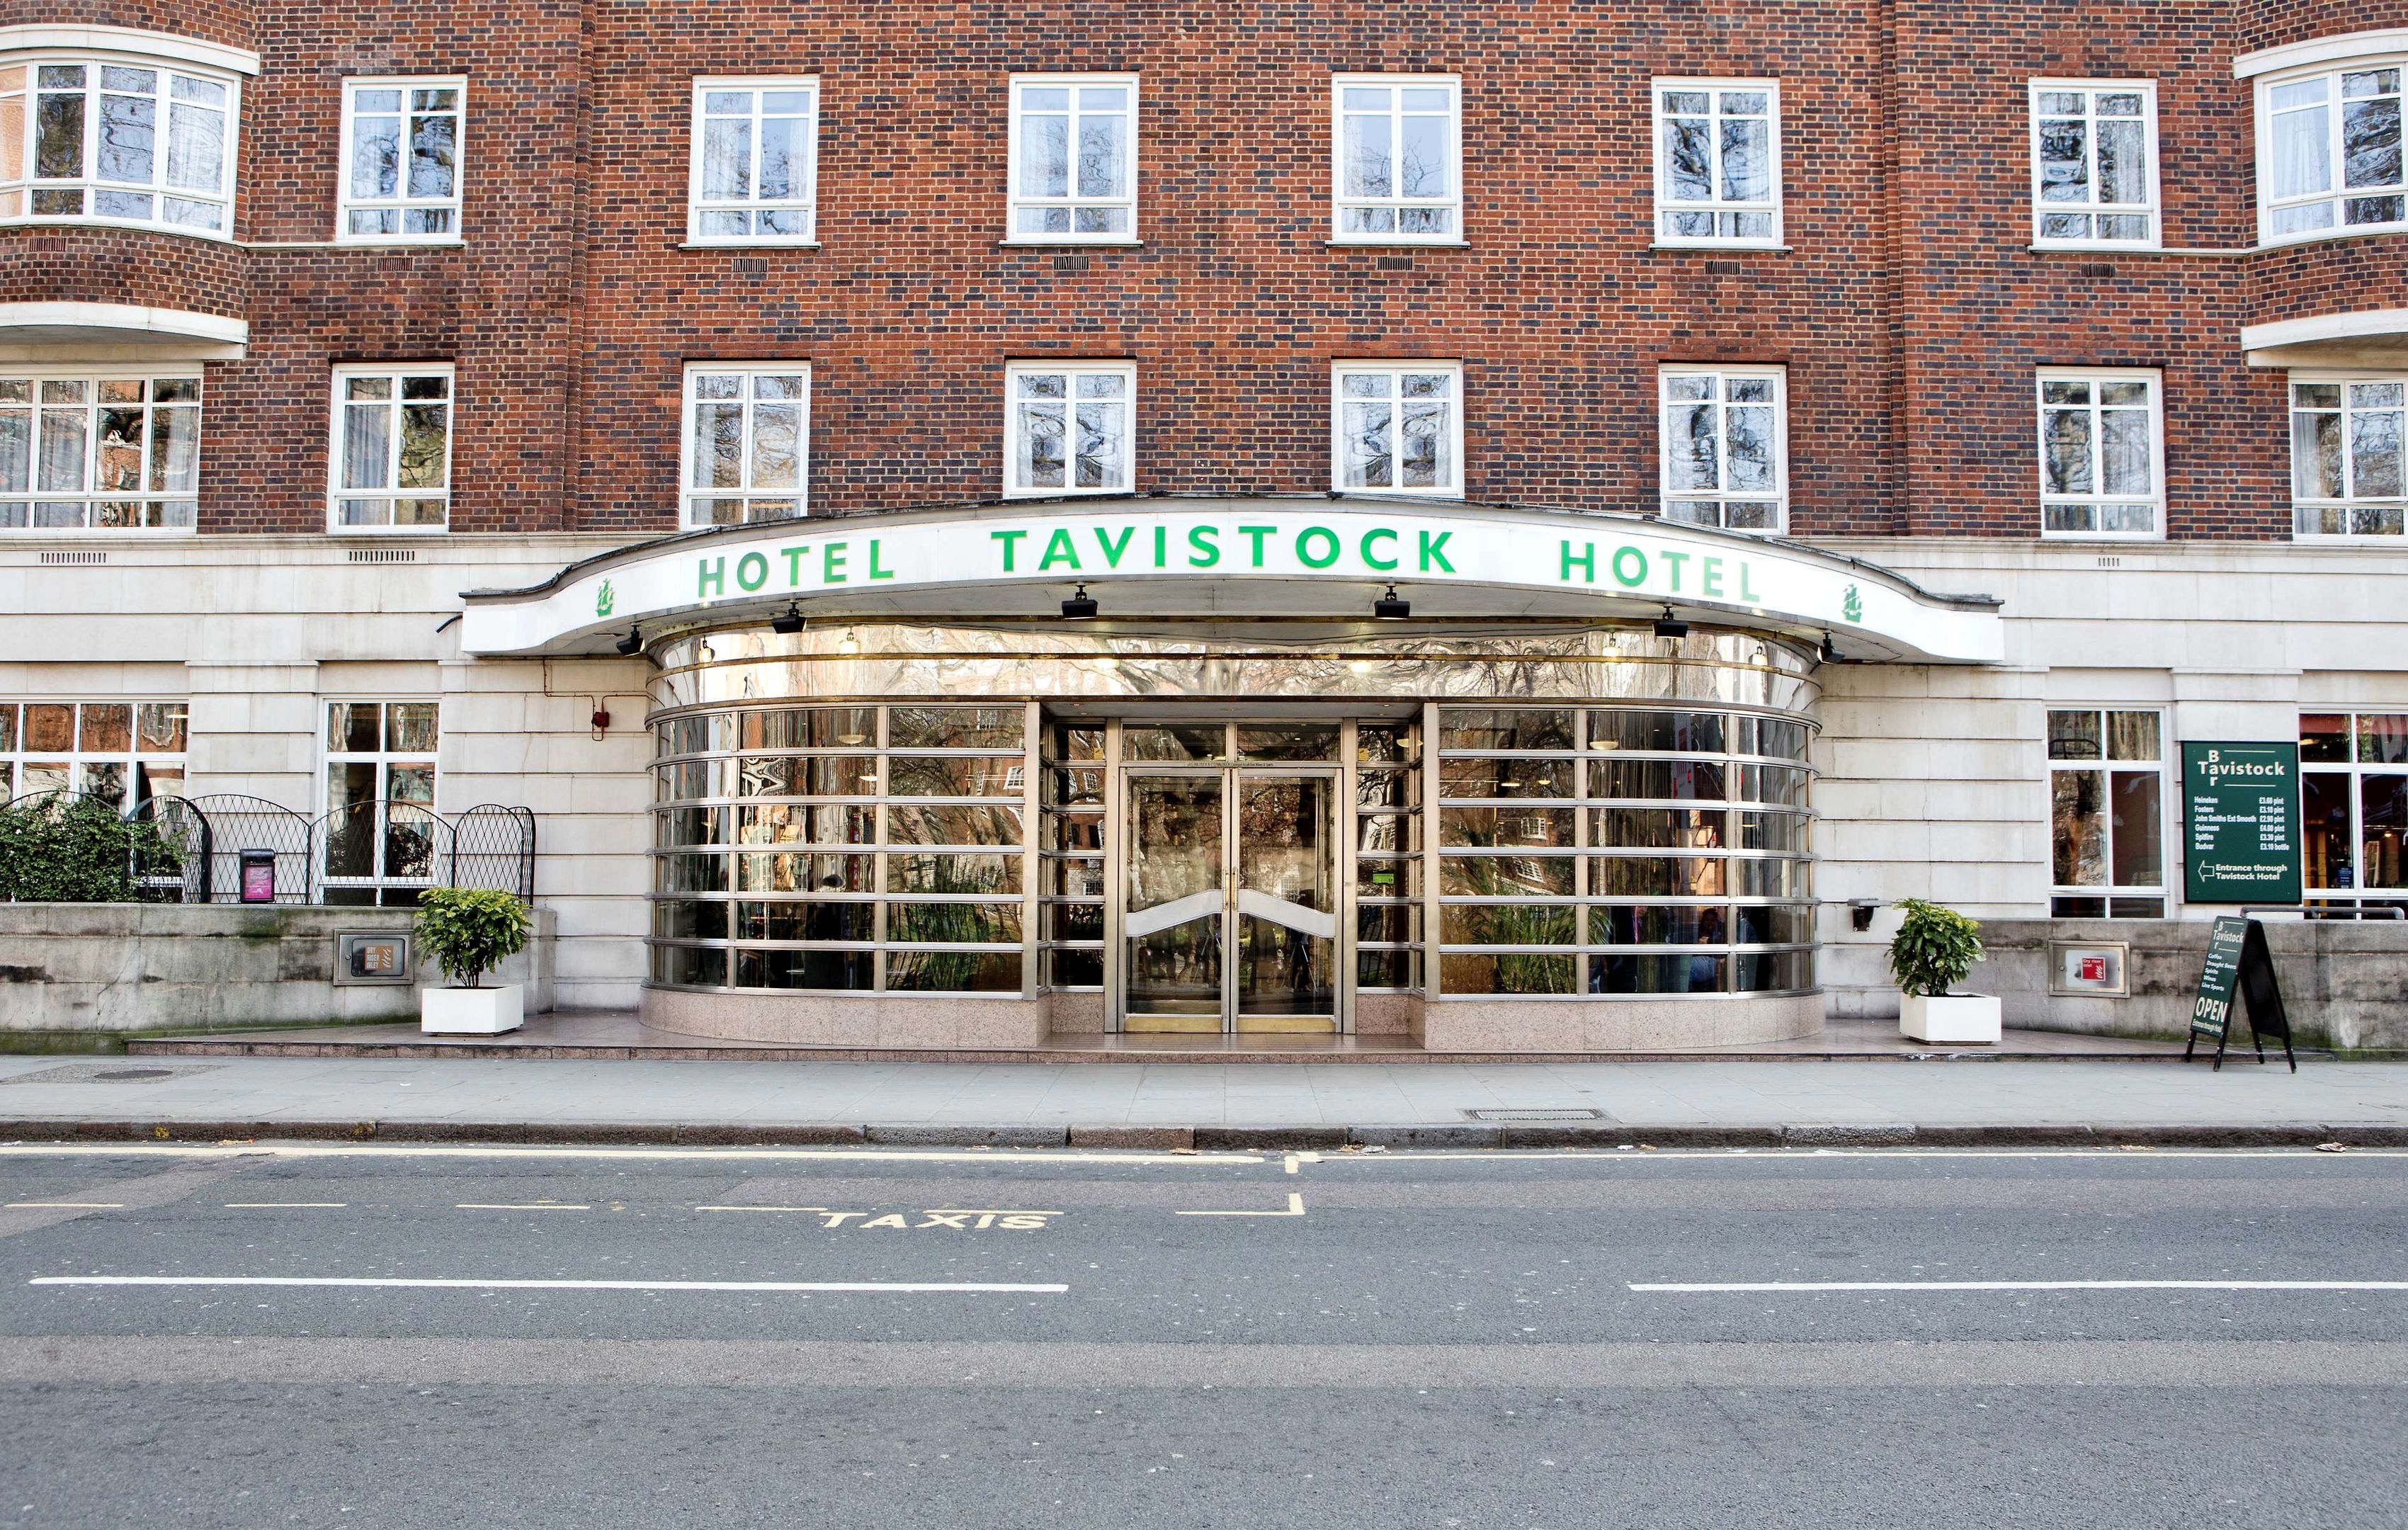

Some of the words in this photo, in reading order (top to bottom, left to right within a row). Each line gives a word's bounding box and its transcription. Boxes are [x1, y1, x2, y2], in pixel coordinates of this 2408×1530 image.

[698, 539, 895, 598] HOTEL
[991, 525, 1456, 572] TAVISTOCK
[1560, 540, 1760, 603] HOTEL
[2197, 761, 2285, 776] Tavistock
[2273, 797, 2284, 805] pint
[2273, 806, 2285, 815] pint
[2273, 815, 2285, 824] pint
[2274, 824, 2285, 833] pint
[2196, 833, 2214, 842] Spitfire
[2274, 834, 2285, 842] pint
[2253, 864, 2288, 873] through
[2213, 929, 2244, 943] Tavistock
[2196, 997, 2228, 1022] OPEN
[819, 1213, 1048, 1229] TAXIS
